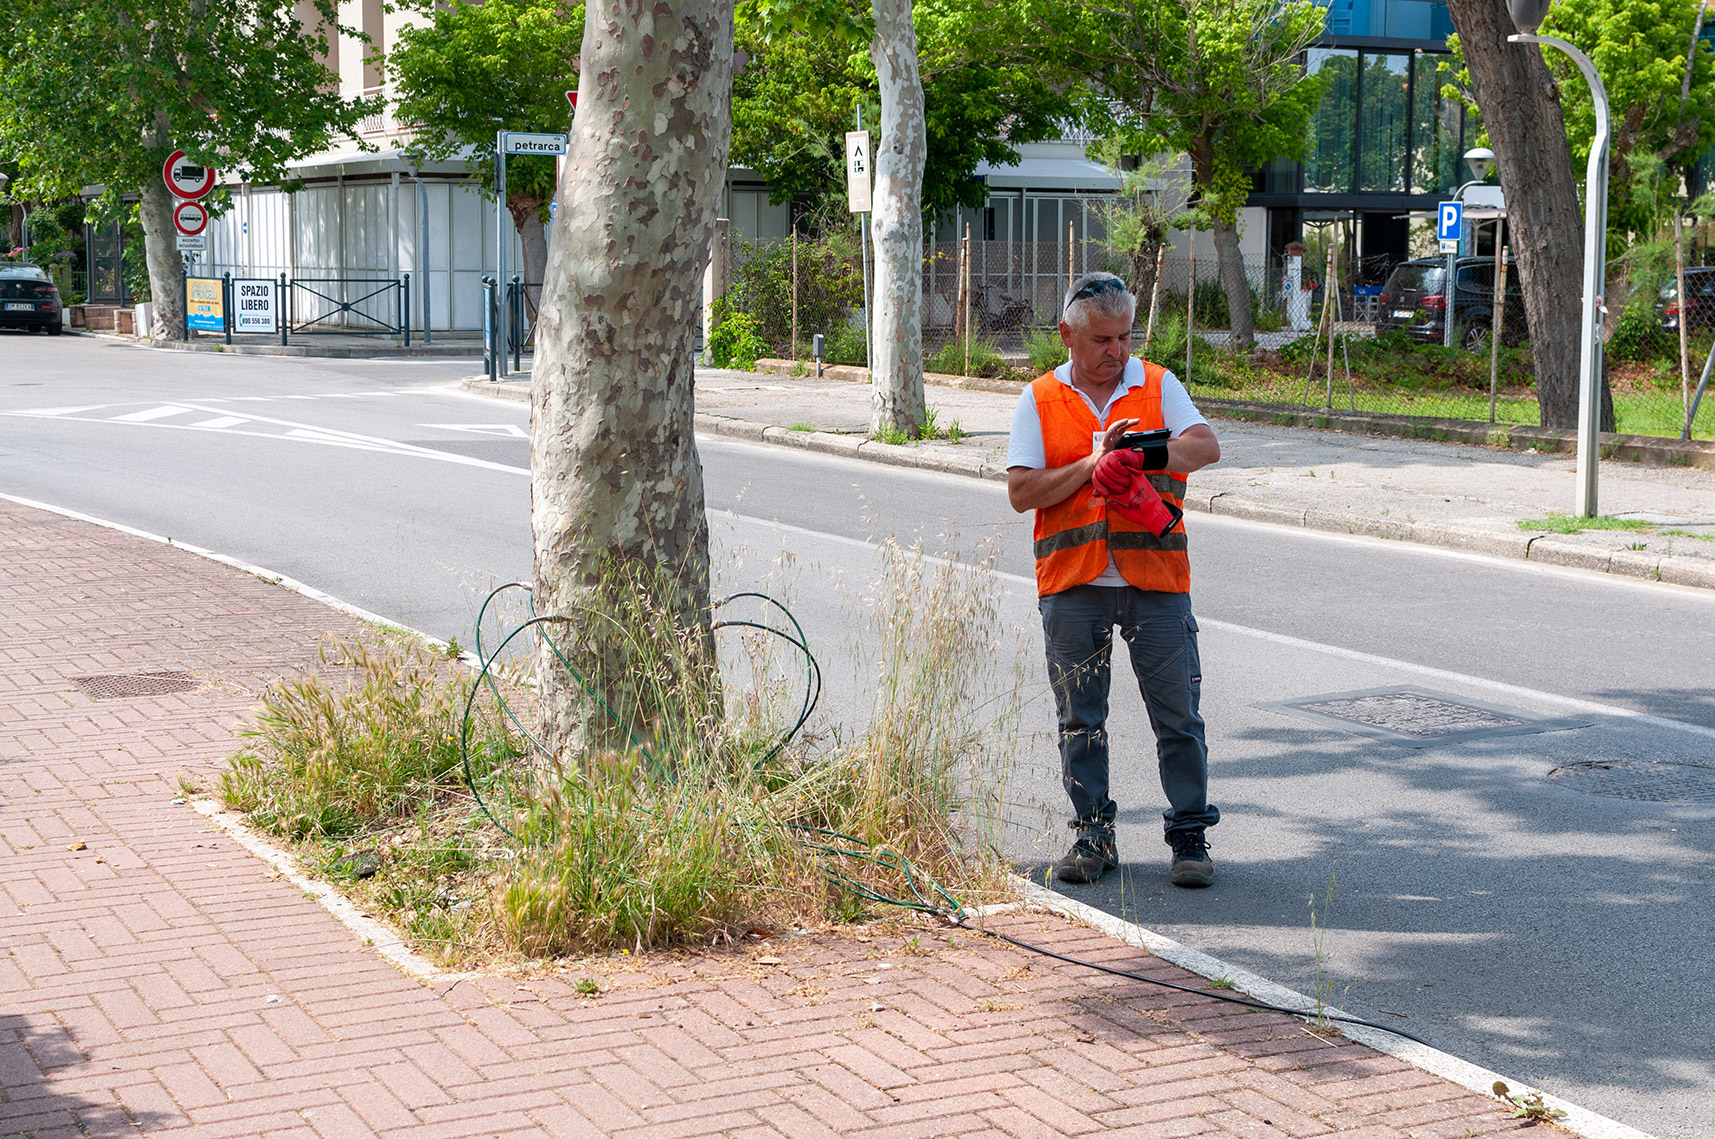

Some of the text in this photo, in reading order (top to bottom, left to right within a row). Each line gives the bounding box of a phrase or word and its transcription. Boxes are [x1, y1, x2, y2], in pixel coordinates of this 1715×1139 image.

[515, 141, 560, 152] petrarca
[1442, 206, 1457, 236] P
[241, 285, 269, 296] SPAZIO
[241, 299, 269, 310] LIBERO
